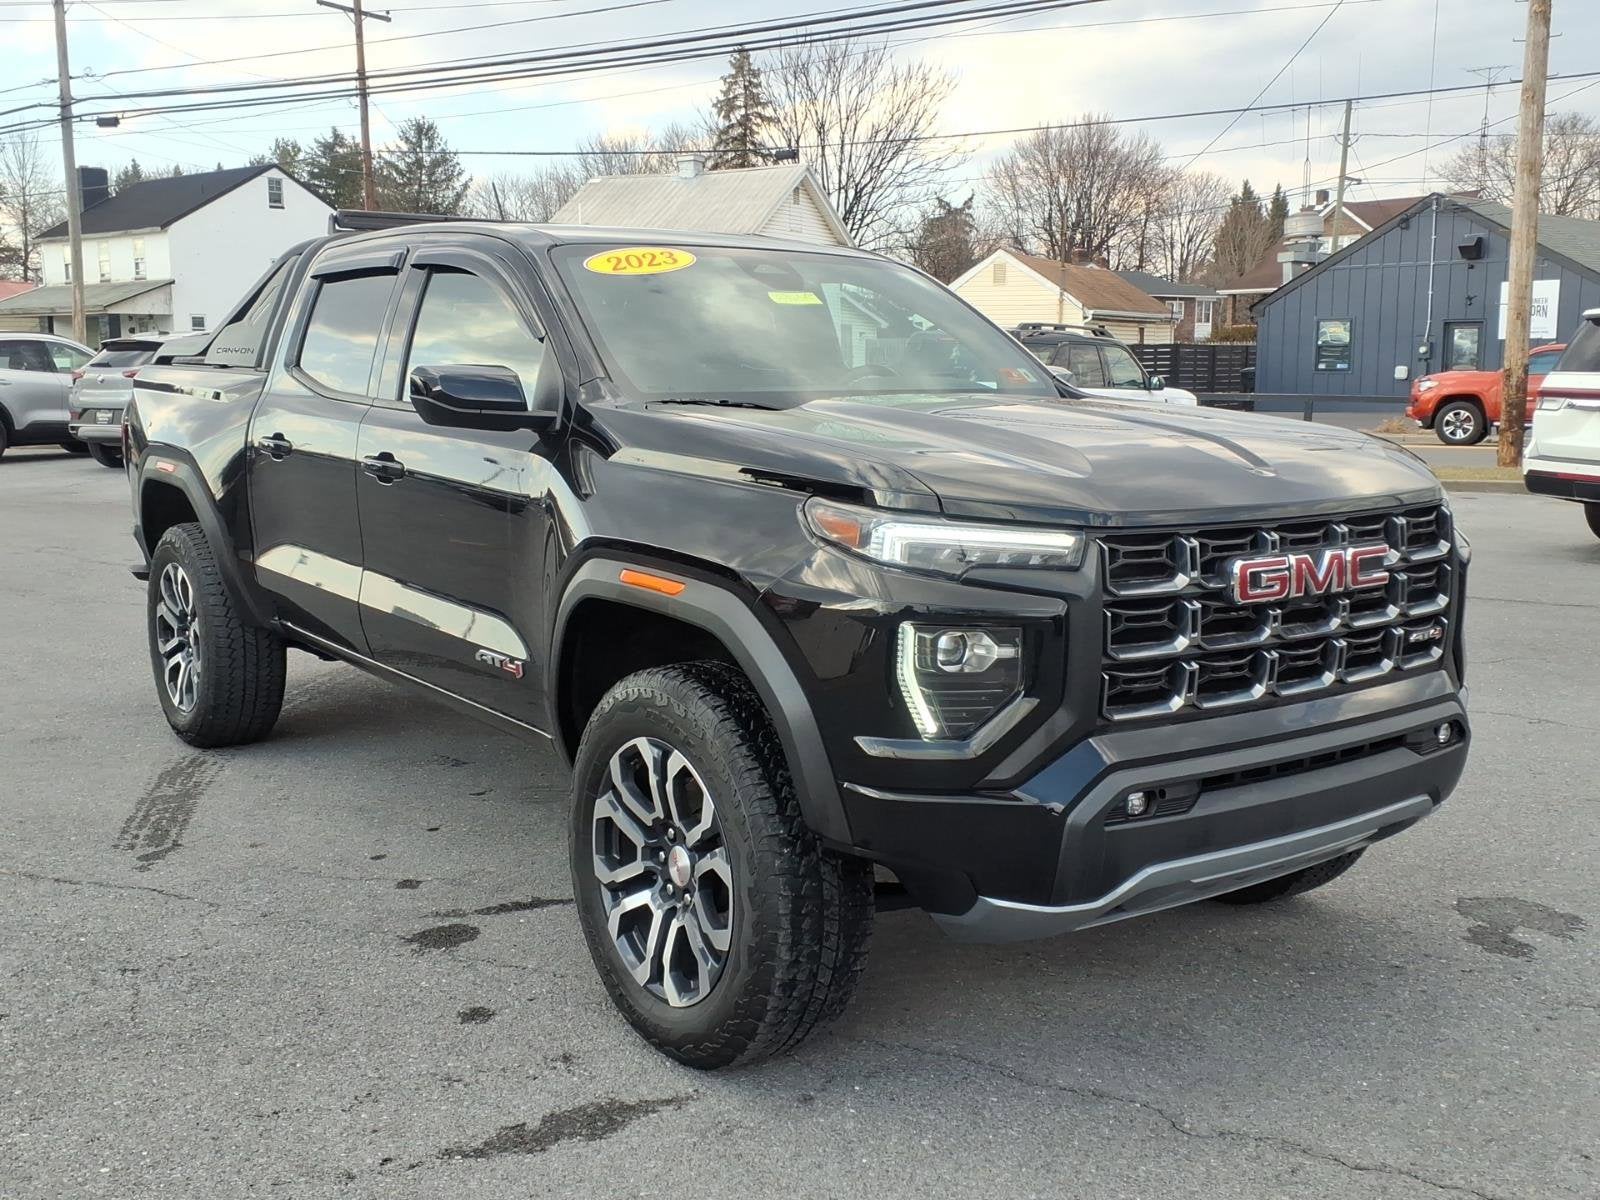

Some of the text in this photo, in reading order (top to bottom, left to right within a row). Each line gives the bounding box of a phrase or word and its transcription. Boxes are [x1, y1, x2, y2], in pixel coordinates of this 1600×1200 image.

[606, 251, 678, 271] 2023
[1233, 544, 1389, 604] GMC
[475, 649, 523, 679] AT4
